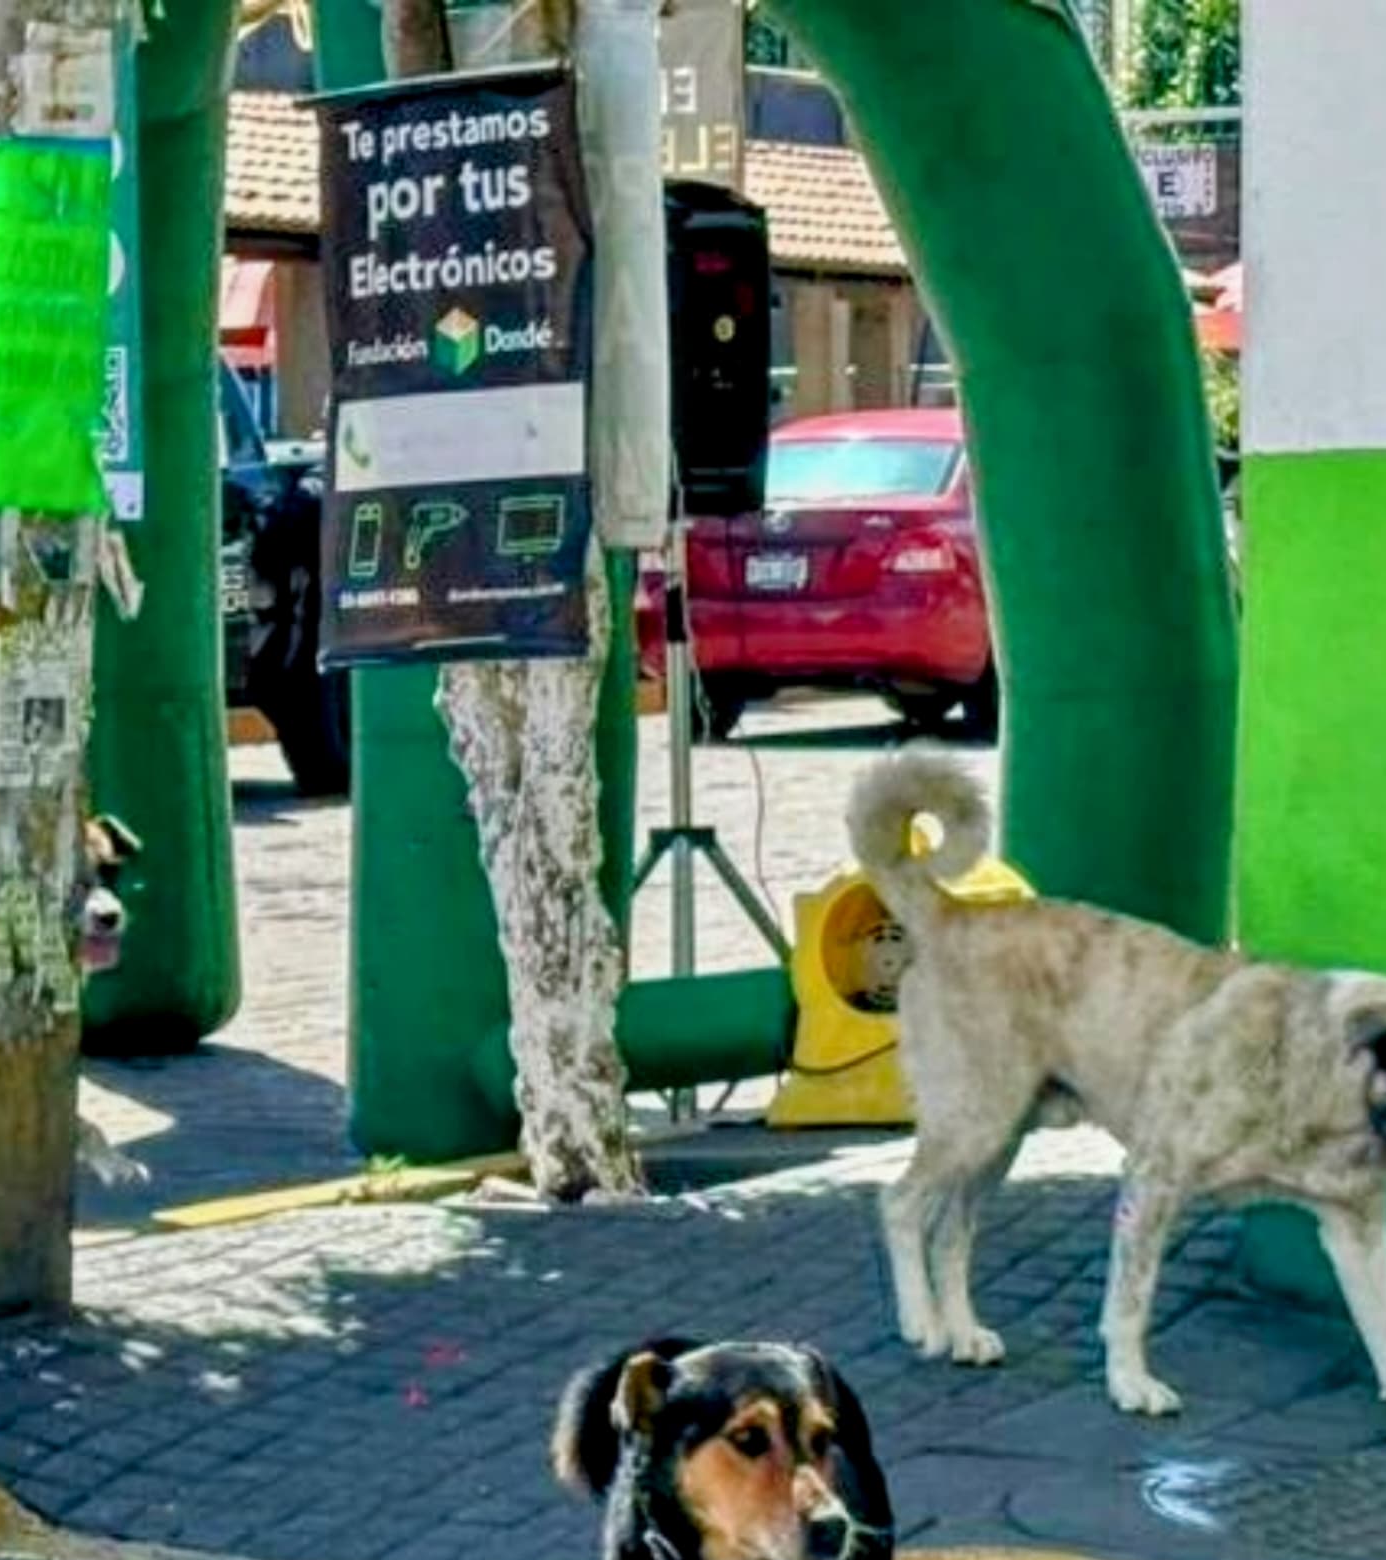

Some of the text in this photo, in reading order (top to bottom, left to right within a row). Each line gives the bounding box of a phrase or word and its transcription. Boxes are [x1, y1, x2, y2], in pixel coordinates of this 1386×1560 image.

[340, 108, 551, 165] Te prestamos
[367, 161, 532, 241] por tus
[349, 240, 557, 299] Electrónicos
[347, 319, 554, 366] Fundación Dondé
